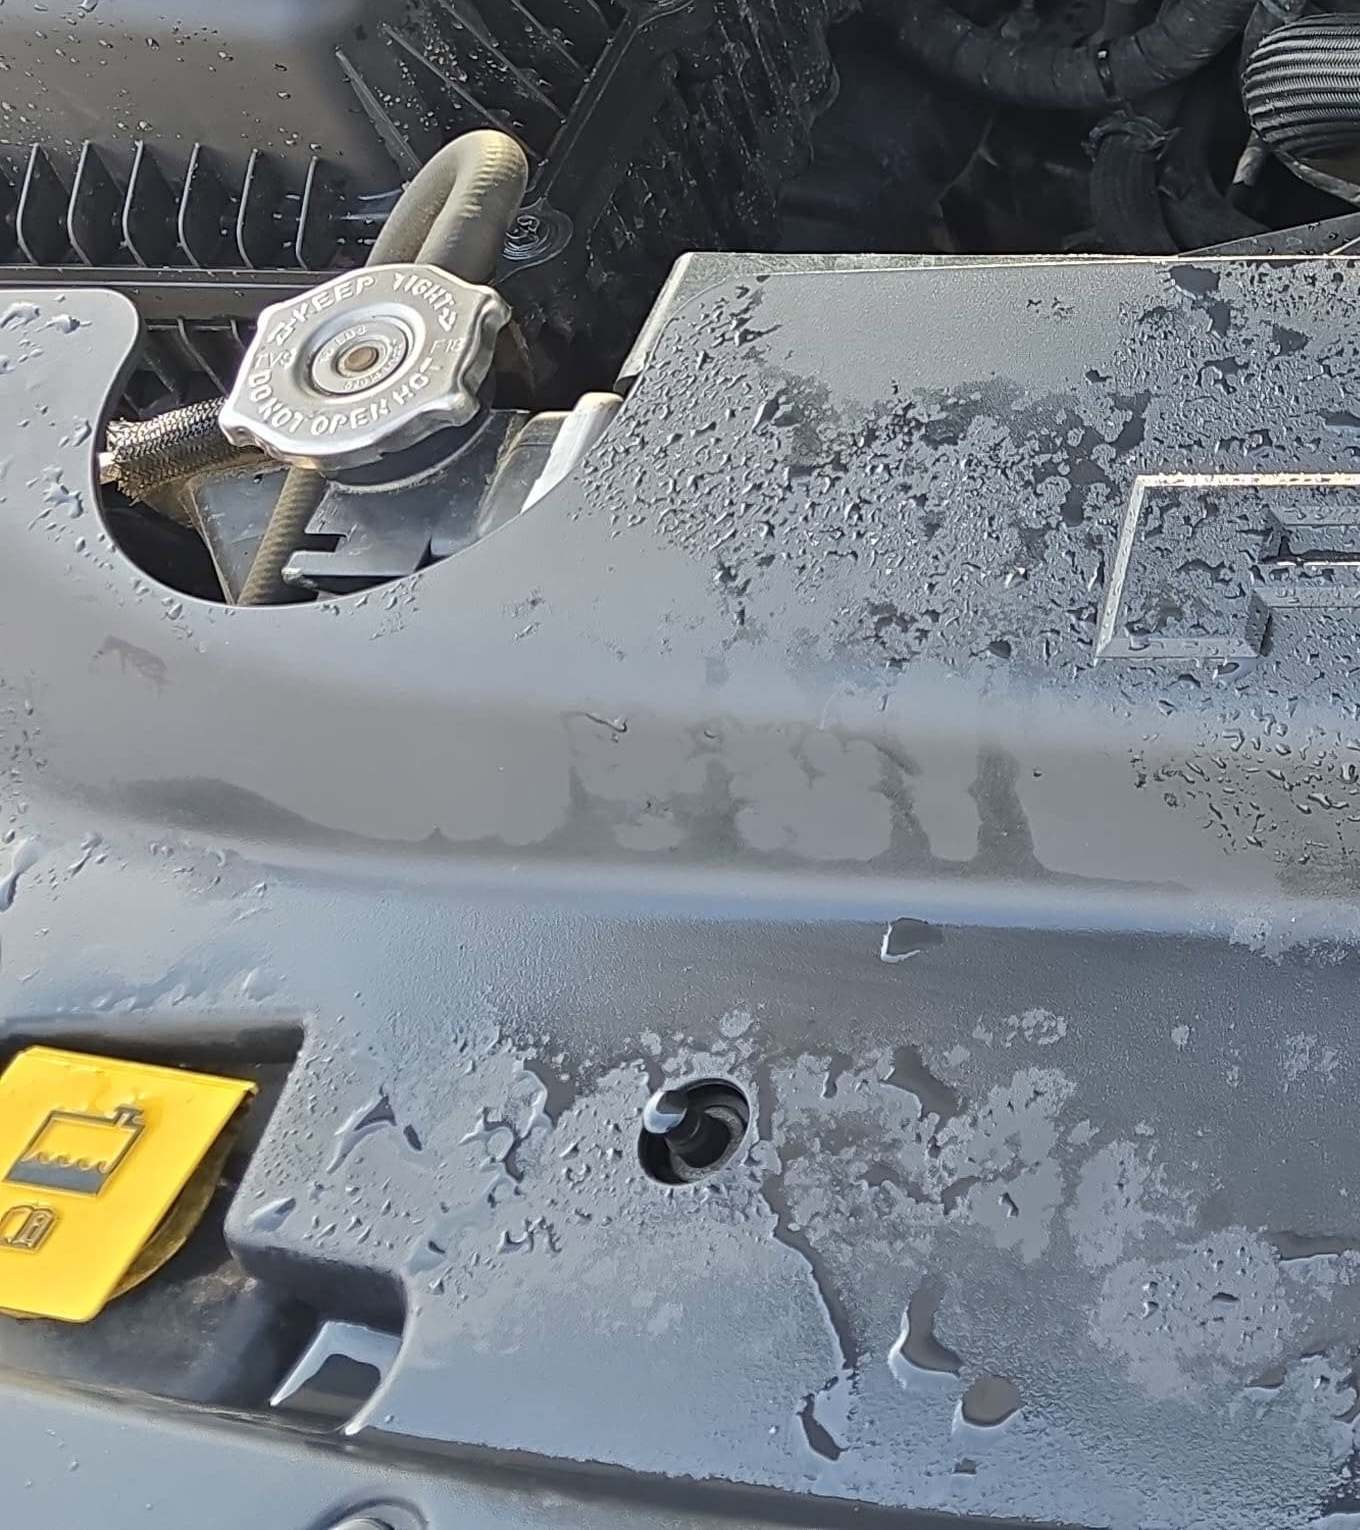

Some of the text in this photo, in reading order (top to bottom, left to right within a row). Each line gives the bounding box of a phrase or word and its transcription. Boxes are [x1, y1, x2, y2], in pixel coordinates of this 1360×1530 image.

[292, 272, 455, 322] KEEP TIGHT
[257, 398, 308, 434] NOT
[309, 399, 393, 436] OPEN
[391, 356, 441, 408] HOT
